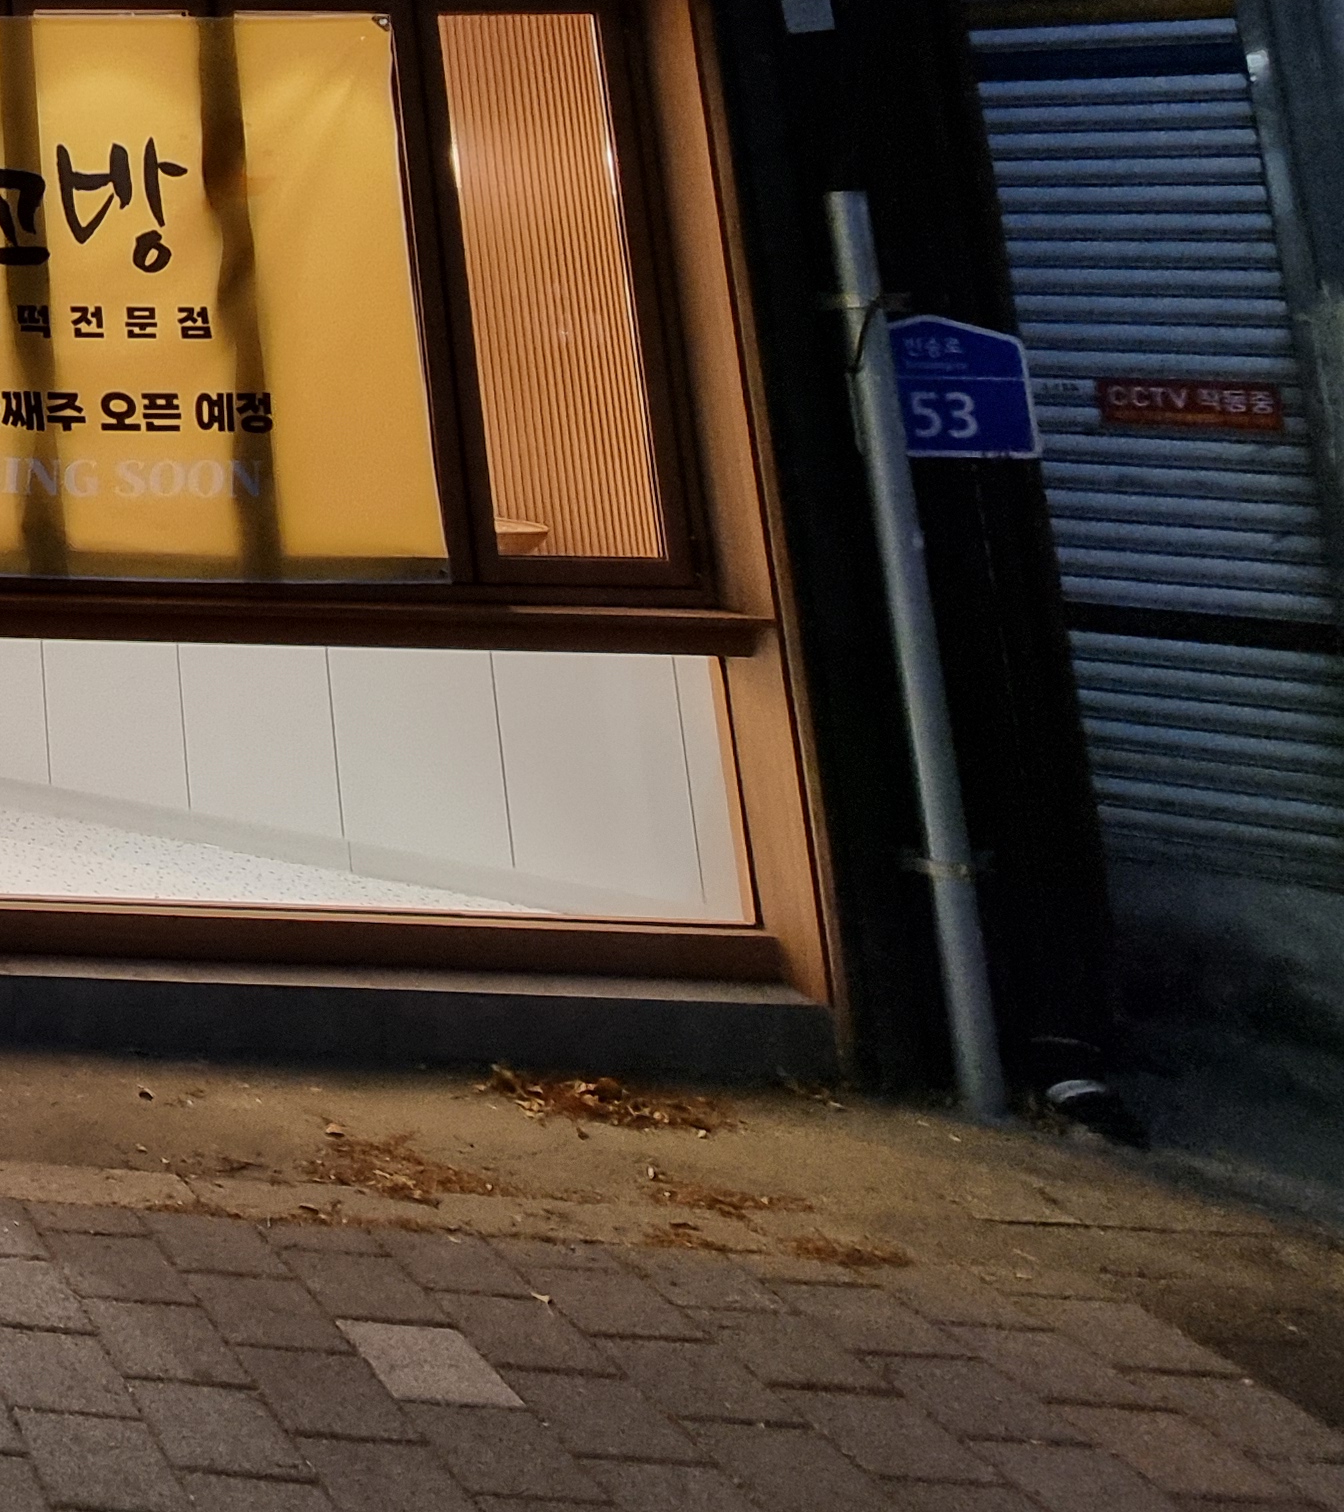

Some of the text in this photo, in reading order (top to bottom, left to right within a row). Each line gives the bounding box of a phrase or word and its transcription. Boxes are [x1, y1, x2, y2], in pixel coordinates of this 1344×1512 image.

[100, 391, 182, 432] 오픈
[194, 391, 275, 435] 예정
[911, 391, 979, 439] 53
[1108, 385, 1189, 410] CCTV
[113, 457, 263, 499] SOON
